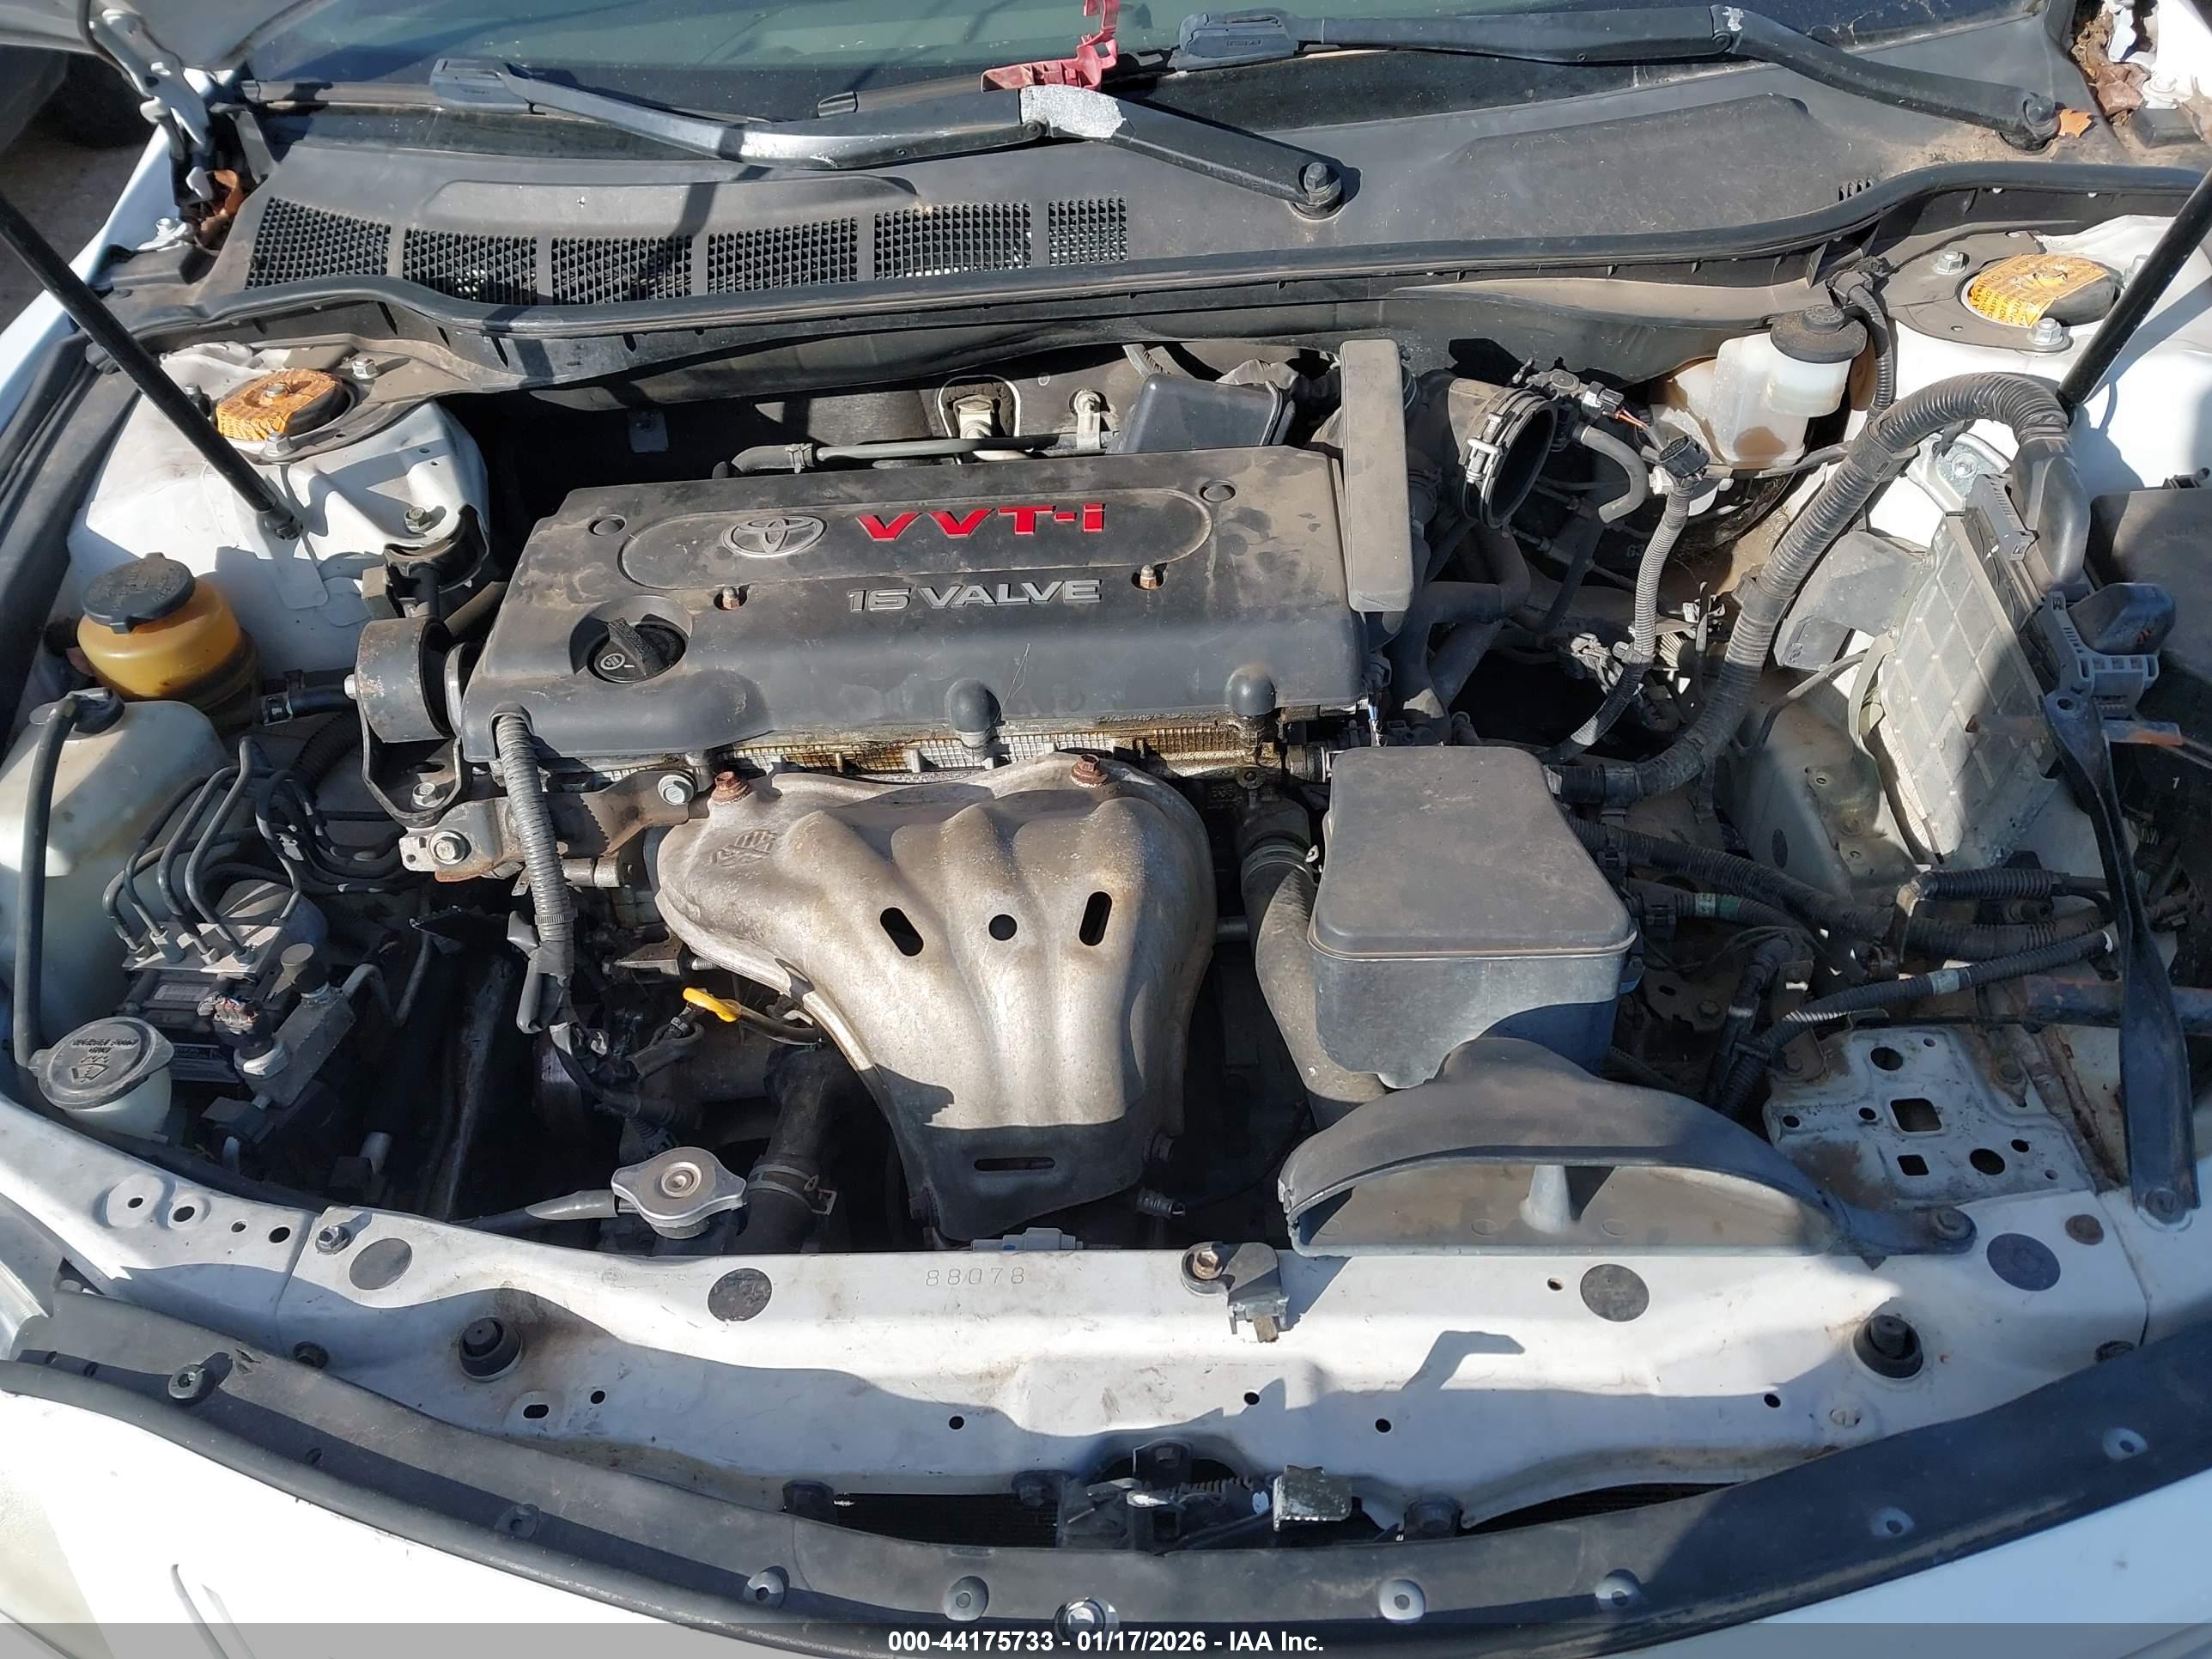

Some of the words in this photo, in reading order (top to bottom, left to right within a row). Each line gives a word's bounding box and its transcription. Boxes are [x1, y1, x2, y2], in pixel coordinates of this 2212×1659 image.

[855, 503, 1107, 542] VVT-i
[848, 586, 911, 611] 16
[920, 580, 1102, 610] VALVE
[926, 1267, 1024, 1286] 88078
